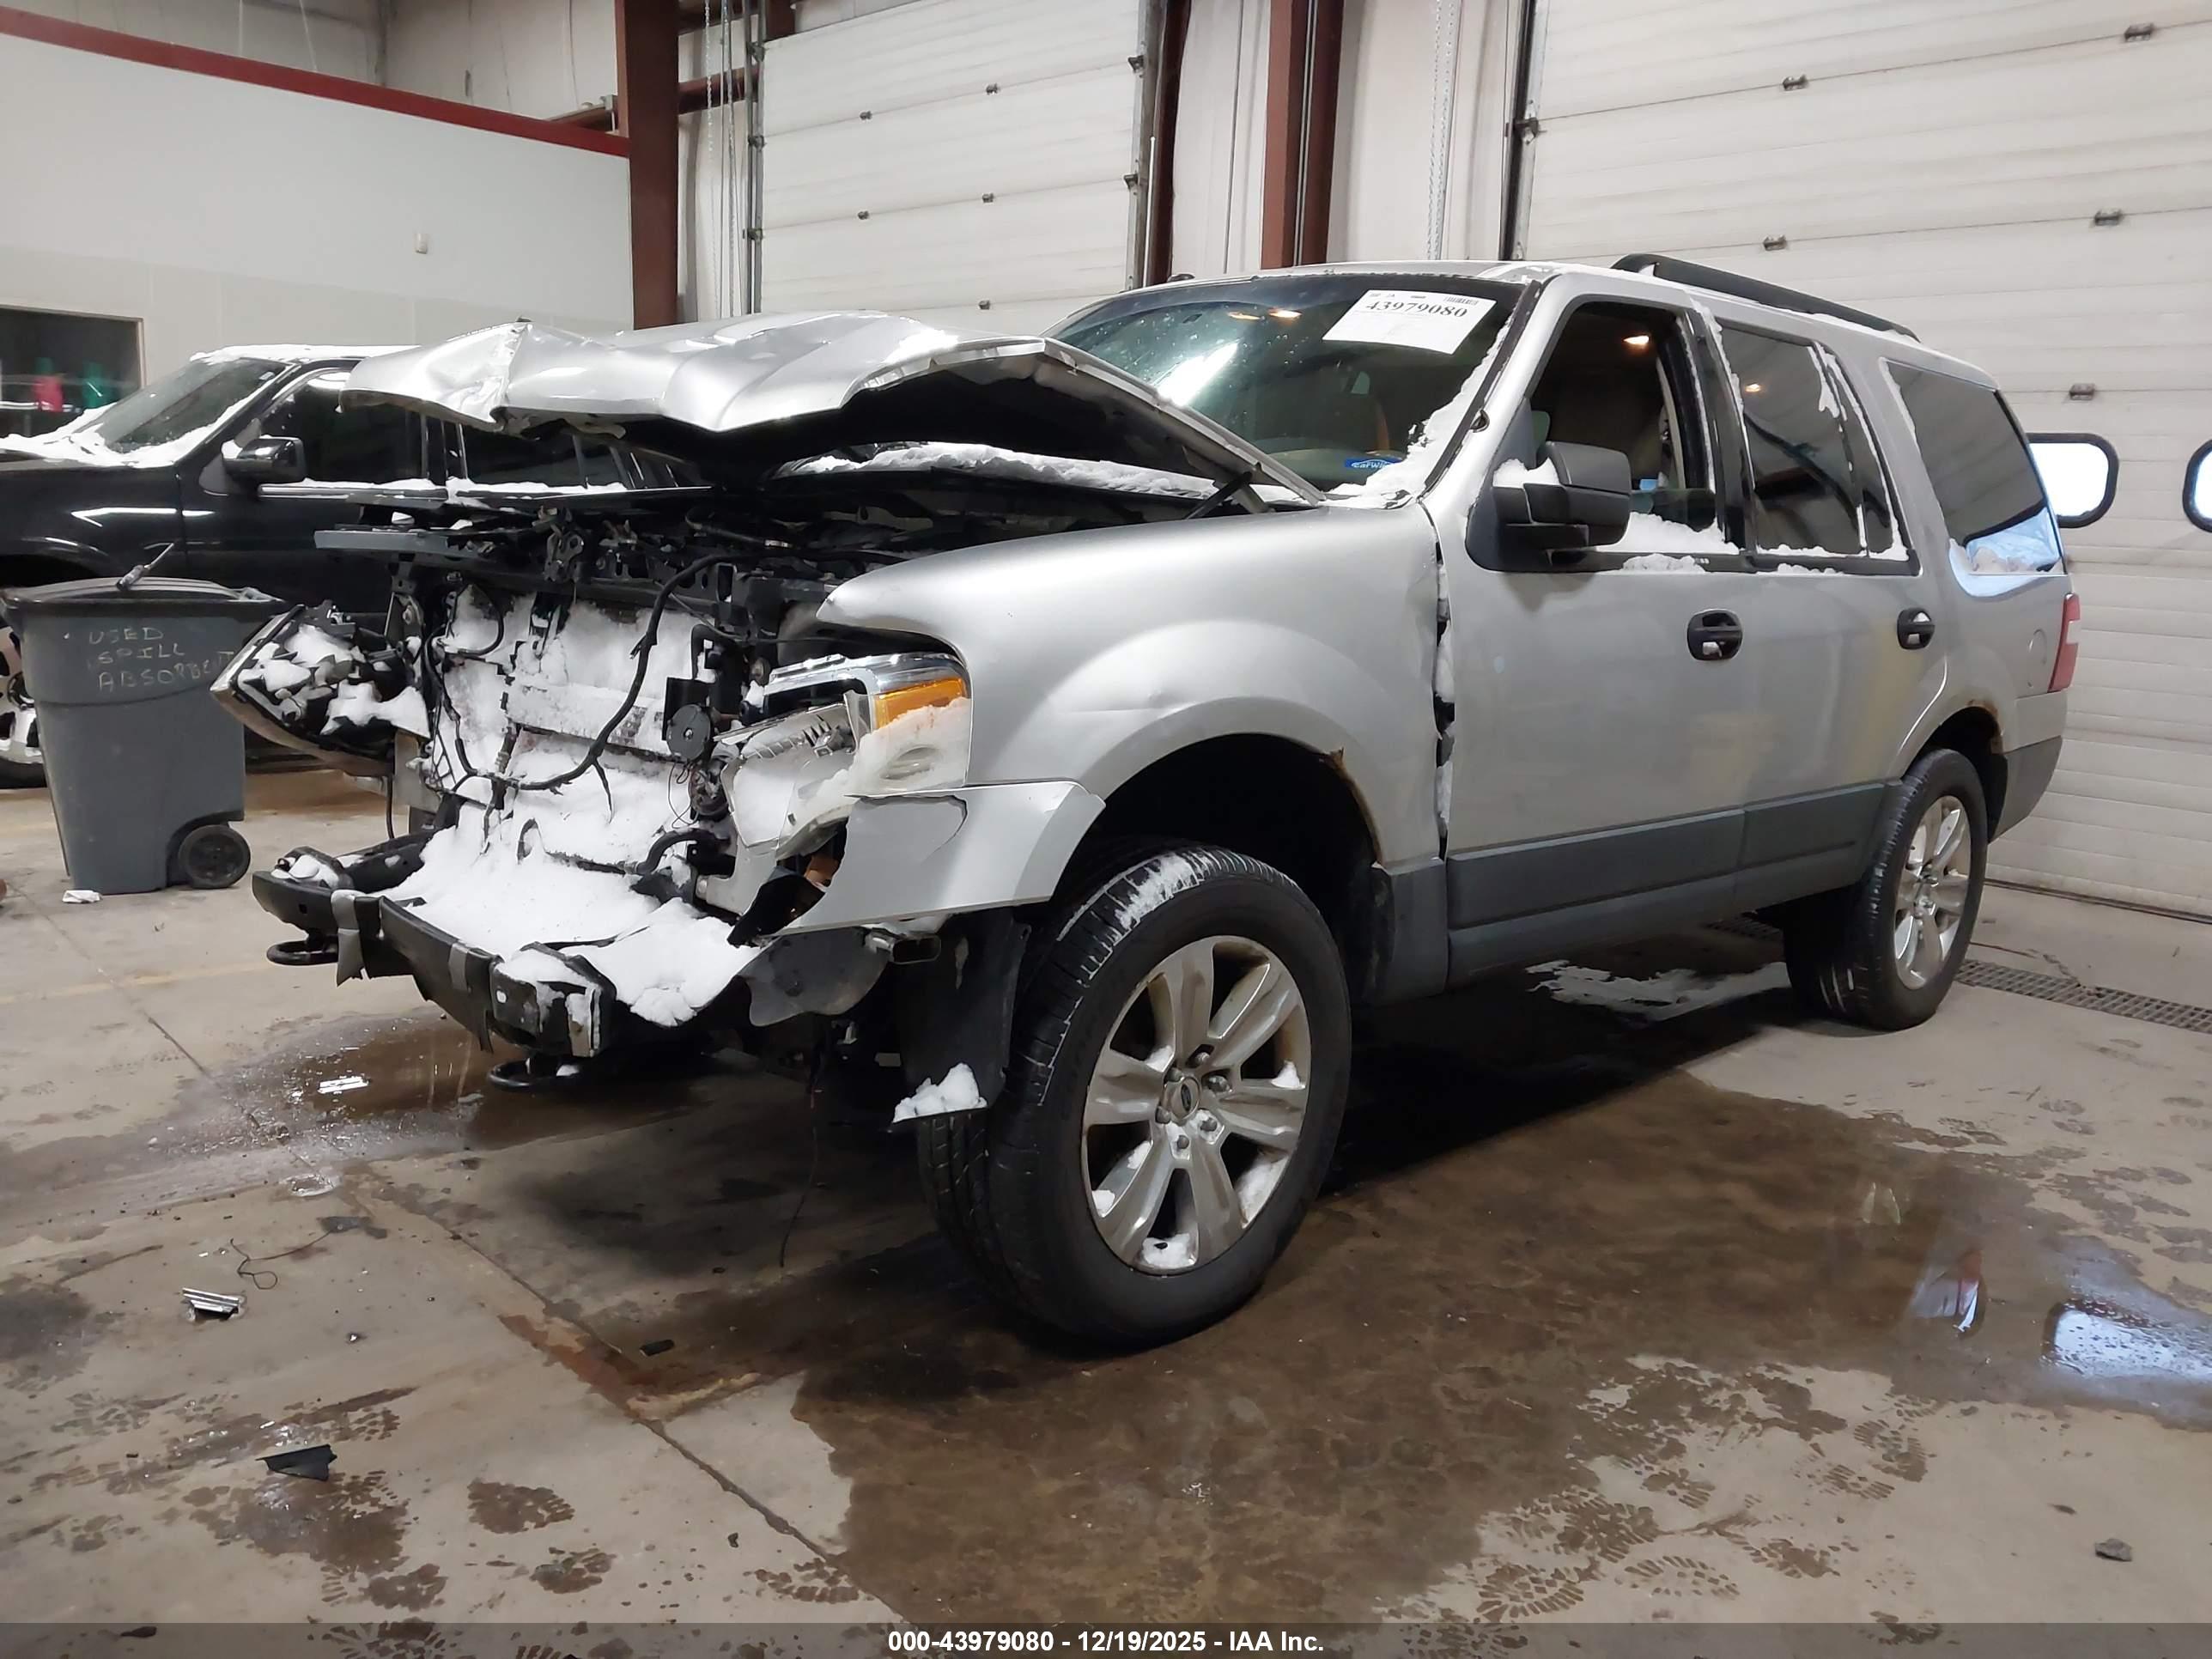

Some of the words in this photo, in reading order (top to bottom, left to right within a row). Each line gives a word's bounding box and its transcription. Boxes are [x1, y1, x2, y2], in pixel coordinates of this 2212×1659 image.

[1365, 300, 1468, 319] 43979080
[88, 627, 164, 644] USED
[98, 644, 185, 665] SPILL
